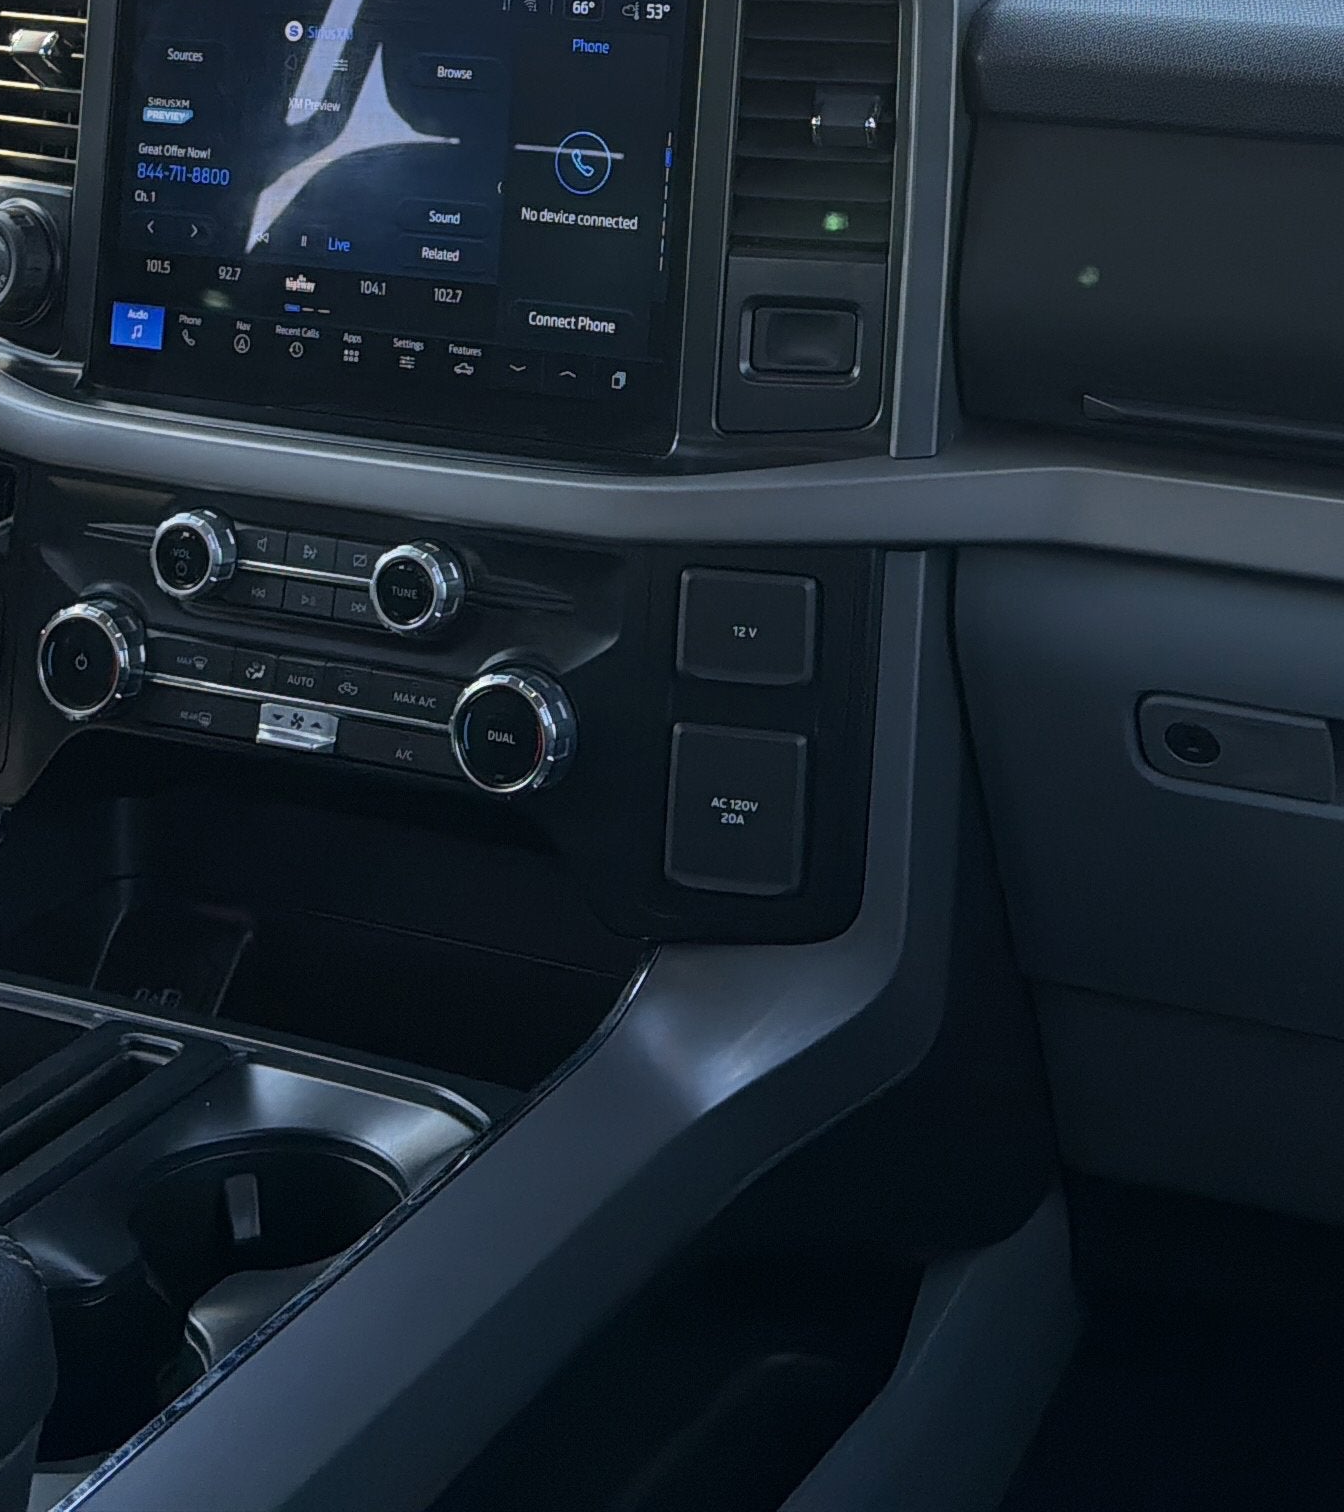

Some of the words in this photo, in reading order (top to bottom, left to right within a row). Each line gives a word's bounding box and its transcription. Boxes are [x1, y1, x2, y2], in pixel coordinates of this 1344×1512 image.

[572, 0, 595, 14] 66°
[646, 3, 671, 19] 53°
[572, 38, 610, 54] Phone
[167, 48, 204, 62] Sources
[437, 66, 473, 80] Browse
[147, 96, 190, 109] SIRIUSXM
[288, 97, 303, 110] XM
[304, 98, 342, 112] Preview
[138, 142, 162, 156] Great
[163, 144, 186, 158] Offer
[187, 146, 211, 160] Now!
[137, 162, 230, 186] 844-711-8800
[134, 189, 149, 202] Ch.
[429, 210, 460, 225] Sound
[521, 206, 538, 221] No
[539, 208, 576, 225] device
[577, 212, 638, 230] connected
[328, 237, 351, 252] Live
[421, 246, 460, 262] Related
[145, 259, 171, 274] 101.5
[218, 266, 242, 281] 92.7
[360, 280, 387, 296] 104.1
[433, 287, 462, 303] 102.7
[127, 309, 149, 320] Audio
[178, 314, 202, 326] Phone
[236, 321, 251, 331] Nav
[528, 311, 576, 330] Connect
[577, 316, 616, 334] Phone
[275, 324, 301, 337] Recent
[302, 327, 320, 339] Calls
[343, 332, 362, 344] Apps
[393, 338, 425, 352] Settings
[448, 343, 482, 357] Features
[173, 548, 191, 560] VOL
[391, 586, 419, 600] TUNE
[733, 625, 746, 638] 12
[748, 628, 758, 639] V
[287, 674, 315, 688] AUTO
[393, 691, 417, 705] MAX
[418, 695, 437, 709] A/C
[487, 729, 516, 745] DUAL
[395, 748, 414, 762] A/C
[711, 797, 728, 810] AC
[729, 799, 759, 813] 120V
[720, 812, 745, 826] 20A
